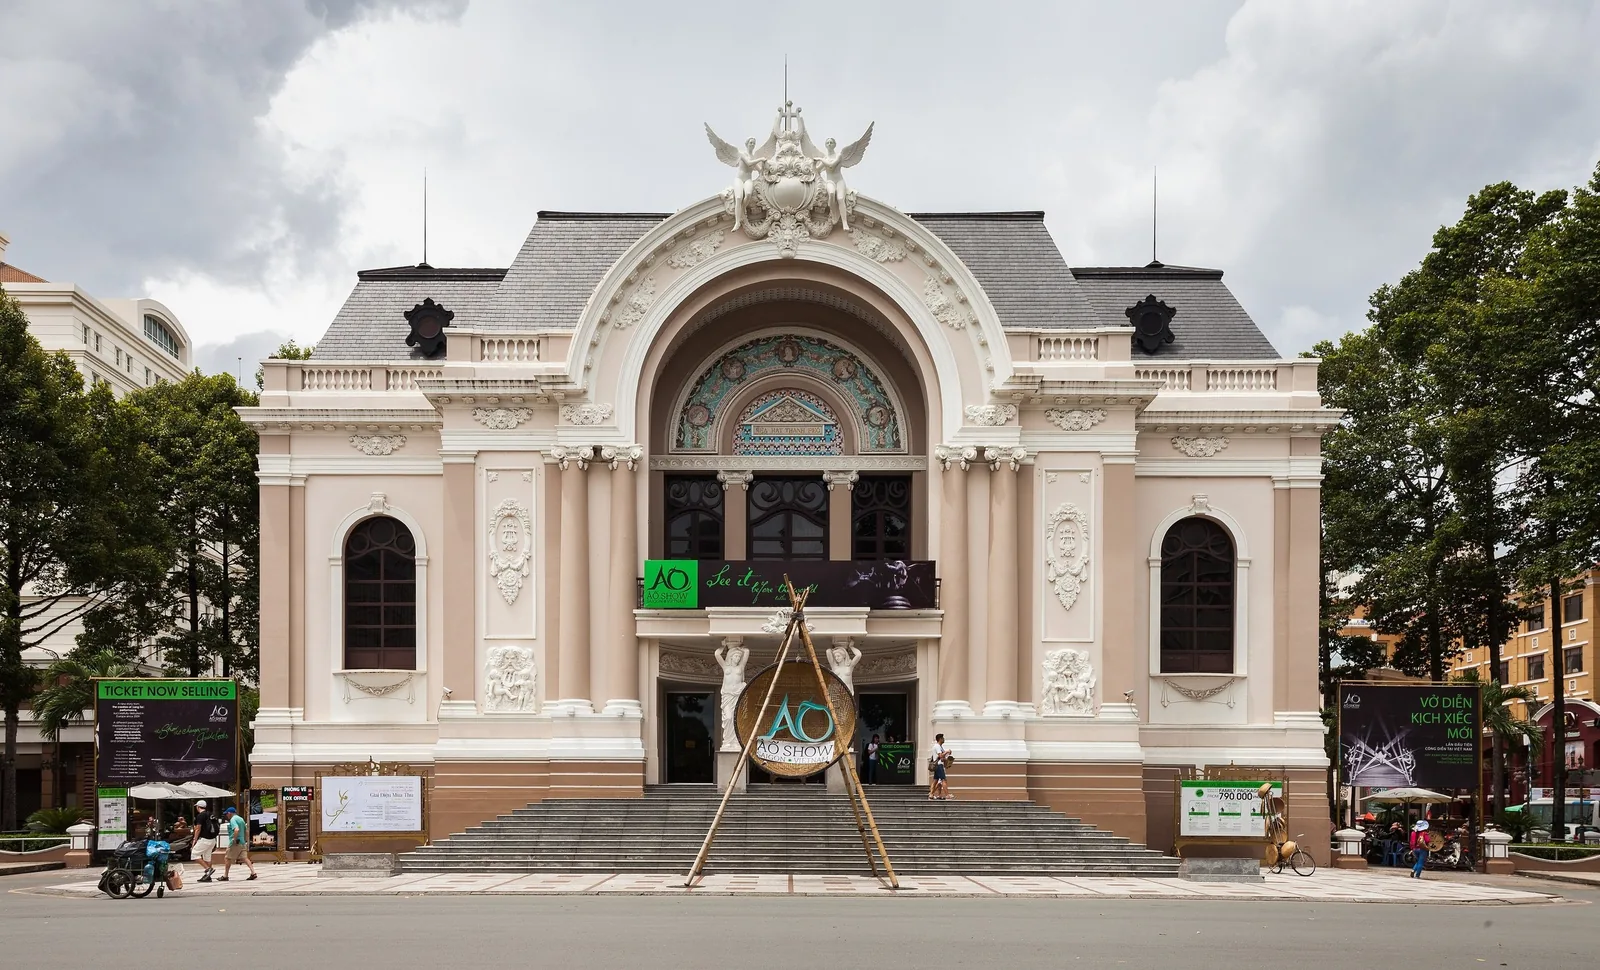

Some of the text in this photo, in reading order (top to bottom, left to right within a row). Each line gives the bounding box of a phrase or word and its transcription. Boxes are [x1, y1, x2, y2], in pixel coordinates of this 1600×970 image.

[706, 564, 758, 588] See it
[752, 581, 774, 604] before
[105, 686, 229, 697] TICKET NOW SELLING
[1411, 710, 1472, 725] KỊCH XIẾC
[1448, 727, 1472, 739] MỚI
[783, 744, 833, 757] SHOW
